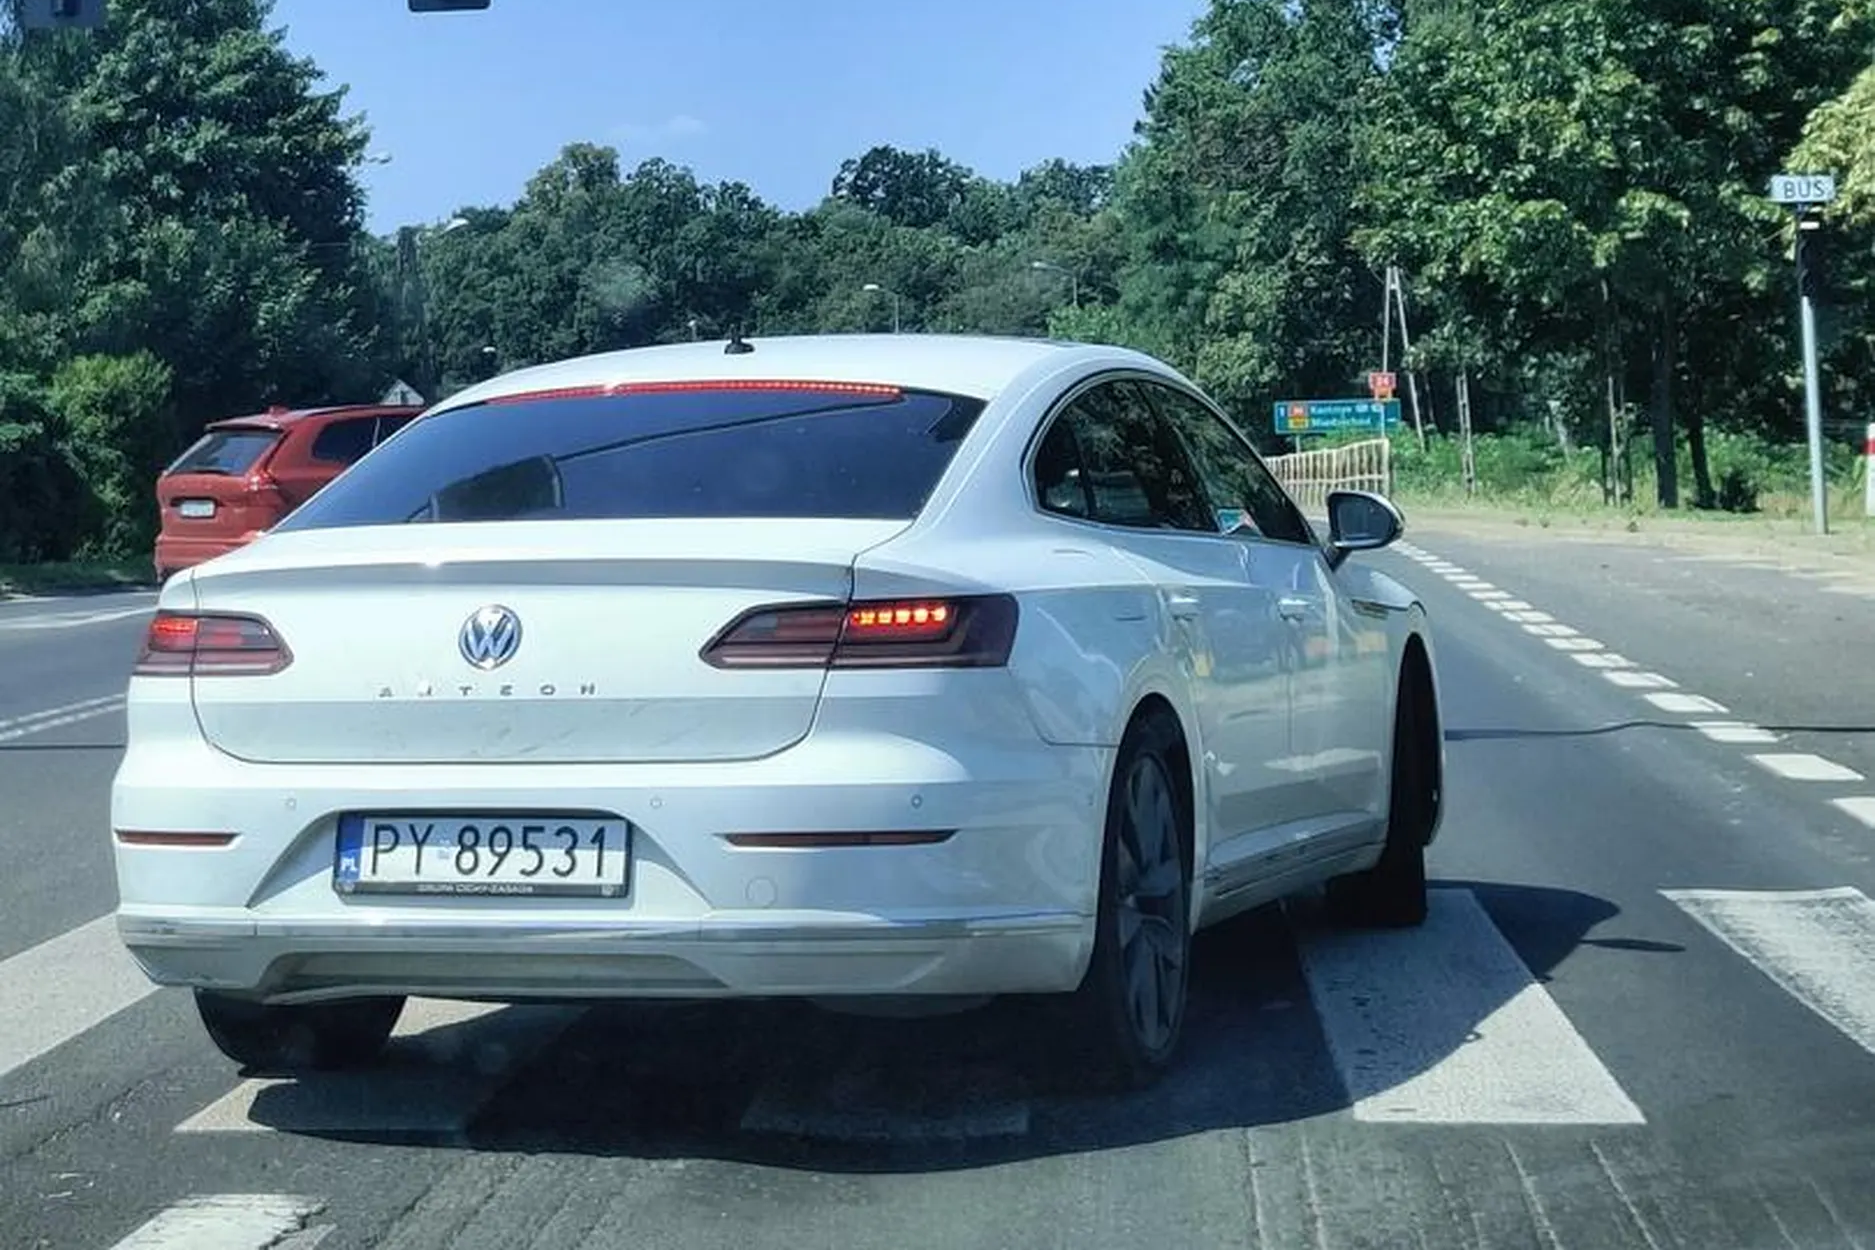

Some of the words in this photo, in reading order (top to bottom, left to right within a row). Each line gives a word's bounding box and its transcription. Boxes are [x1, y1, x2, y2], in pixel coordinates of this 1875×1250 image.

[1783, 180, 1825, 199] BUS
[371, 823, 434, 876] PY
[455, 824, 606, 878] 89531
